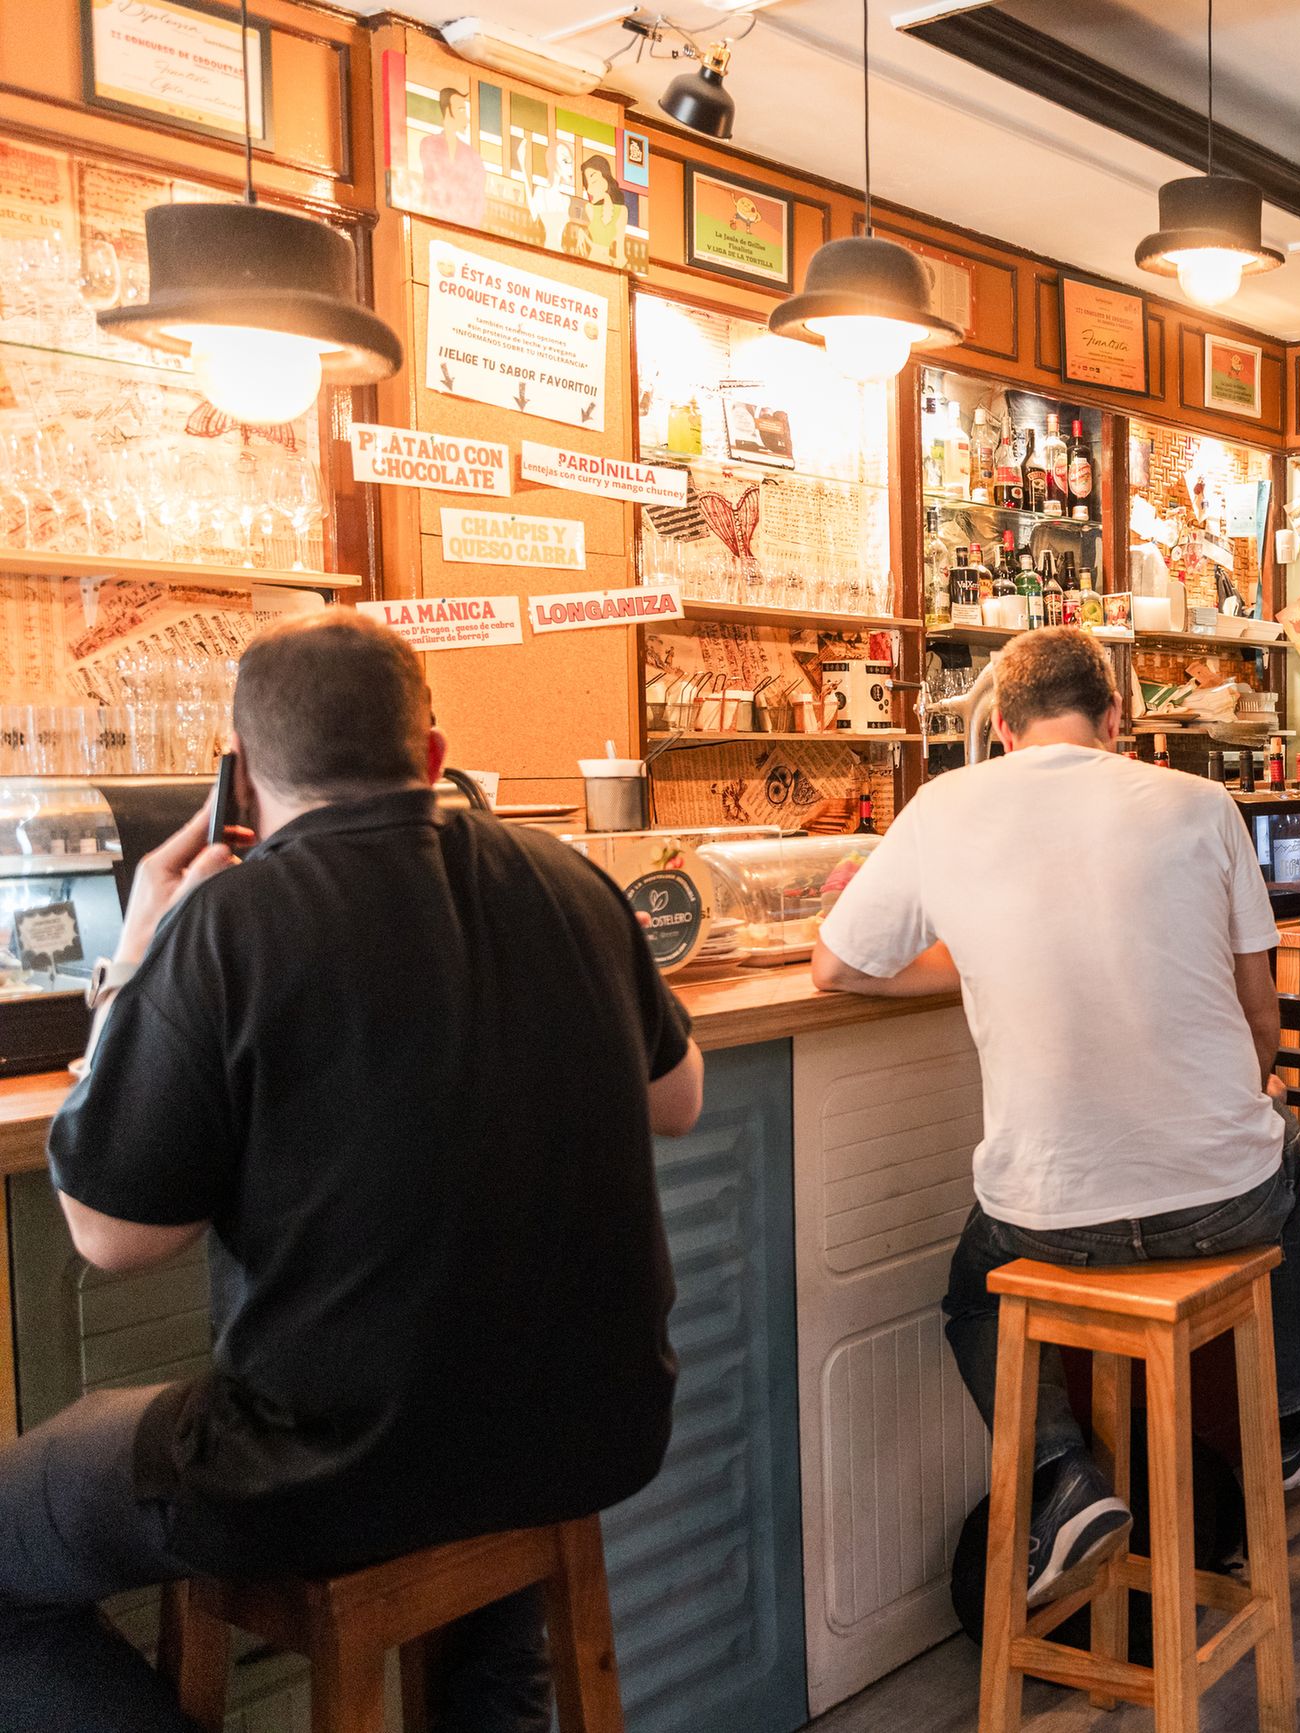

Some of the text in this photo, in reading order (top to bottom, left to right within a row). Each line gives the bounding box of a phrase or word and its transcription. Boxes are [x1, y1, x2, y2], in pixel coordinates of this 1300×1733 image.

[125, 35, 175, 56] CONCURSO
[178, 51, 190, 60] DE
[193, 55, 245, 76] CROQUETAS
[461, 263, 599, 319] ÉSTAS SON NUESTRAS
[439, 280, 579, 331] CROQUETAS CASERAS
[502, 342, 524, 353] SOBRE
[526, 348, 535, 356] TU
[482, 358, 496, 371] TU
[500, 364, 536, 381] SABOR
[464, 446, 504, 469] CON
[372, 457, 495, 489] CHOCOLATE
[523, 462, 558, 477] Lentejas
[559, 471, 576, 481] con
[578, 474, 602, 487] curry
[612, 481, 644, 494] mango
[646, 485, 685, 500] chutney
[461, 516, 567, 544] CHAMPIS Y
[449, 537, 580, 566] QUESO CABRA
[384, 606, 414, 625] LA
[536, 594, 677, 625] LONGANIZA
[456, 625, 478, 633] queso
[480, 622, 489, 630] de
[491, 621, 515, 629] cabra
[458, 631, 489, 641] borraja
